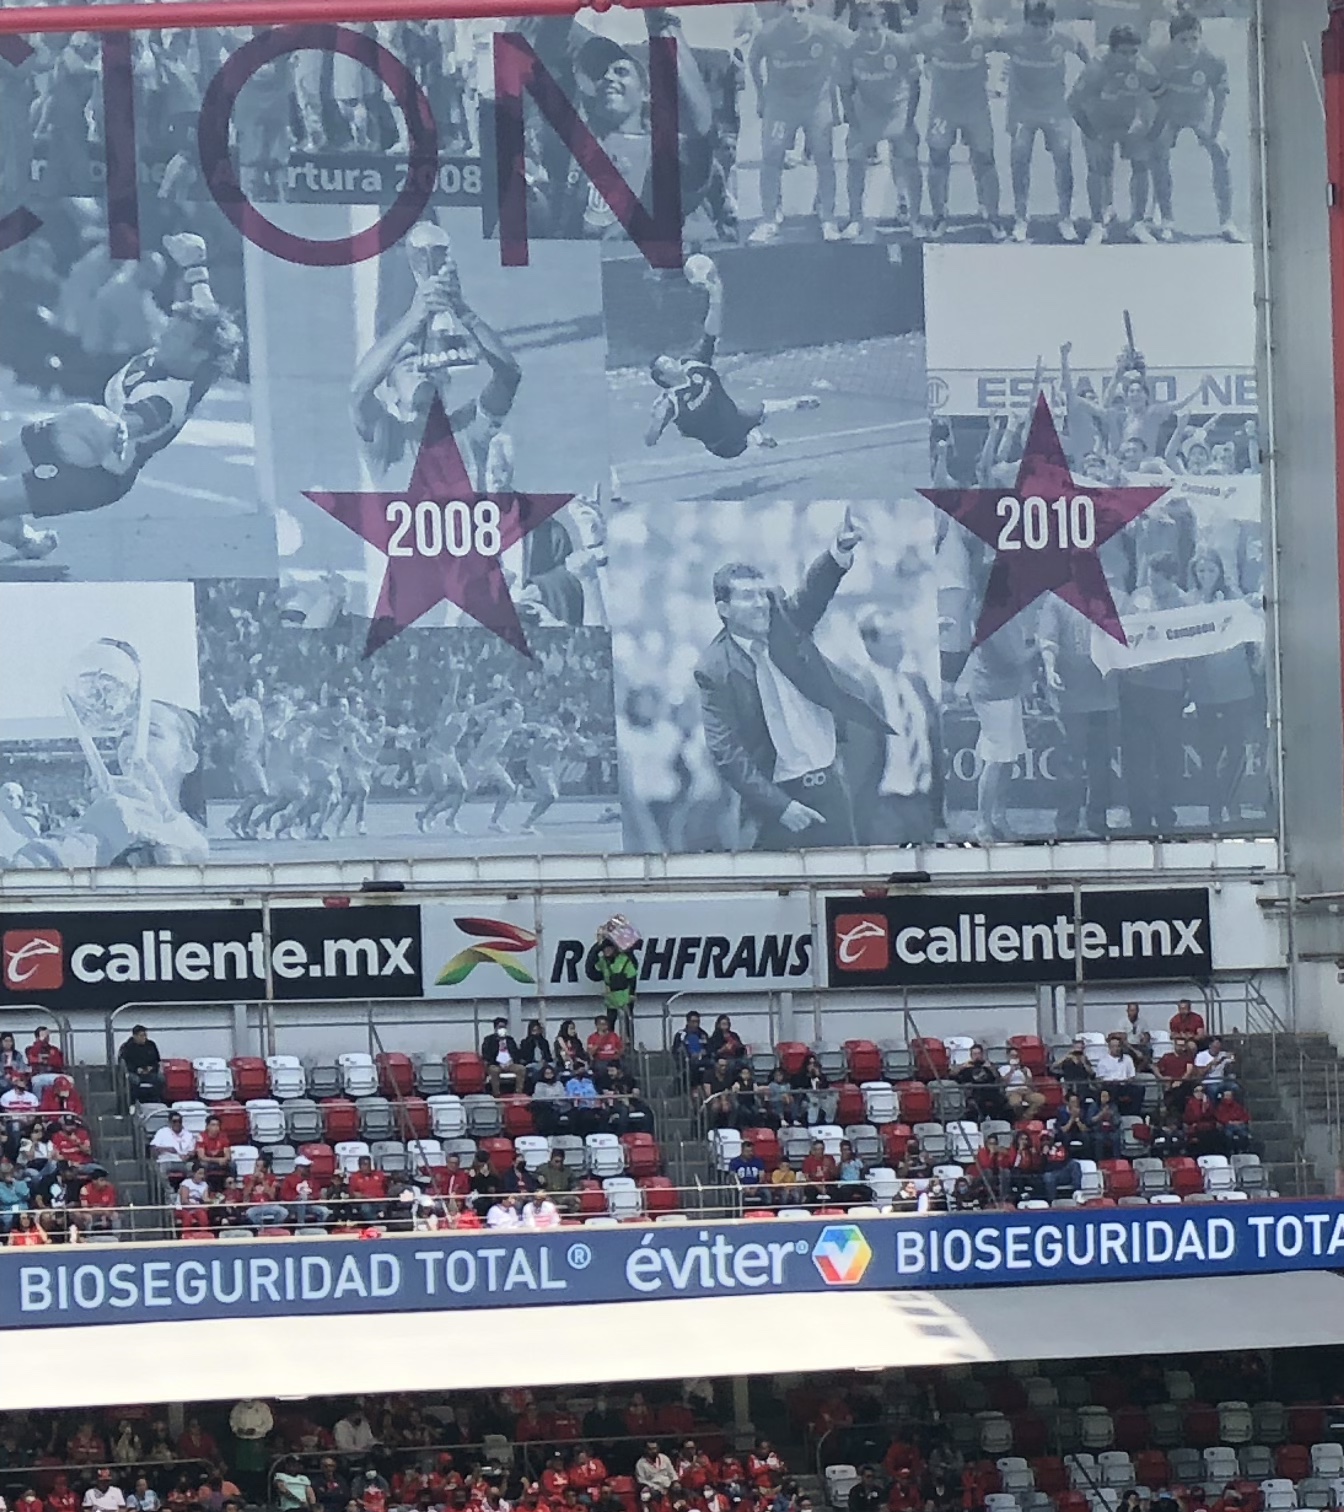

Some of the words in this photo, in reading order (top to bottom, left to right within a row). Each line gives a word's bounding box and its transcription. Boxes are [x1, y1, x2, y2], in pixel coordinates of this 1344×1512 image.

[0, 22, 685, 269] ION
[386, 500, 502, 558] 2008
[996, 495, 1096, 552] 2010
[71, 930, 415, 983] caliente.mx
[896, 913, 1204, 967] caliente.mx
[20, 1253, 402, 1312] BIOSEGURIDAD
[625, 1230, 793, 1292] éviter
[896, 1216, 1236, 1275] BIOSEGURIDAD
